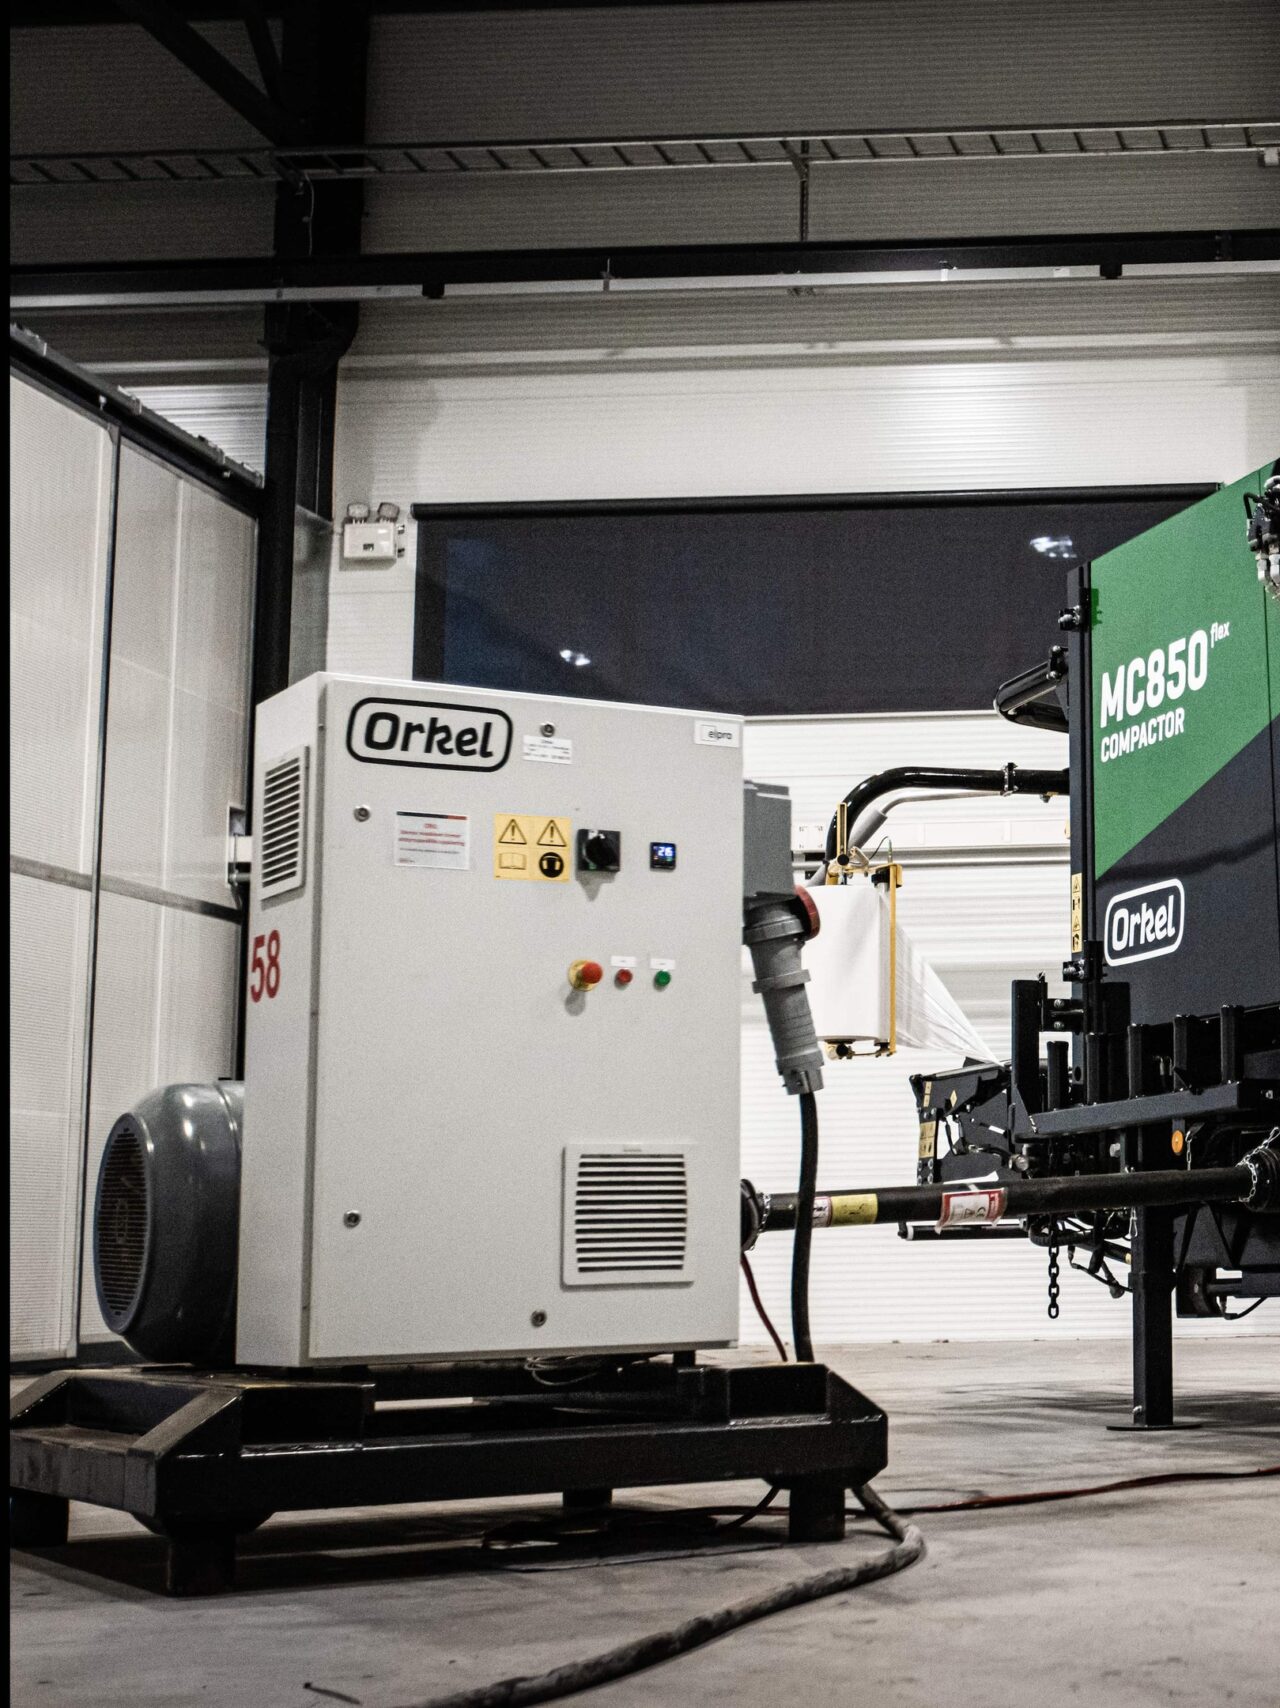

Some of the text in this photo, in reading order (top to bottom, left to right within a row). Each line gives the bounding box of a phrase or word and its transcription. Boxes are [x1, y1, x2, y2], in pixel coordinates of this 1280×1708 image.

[1100, 621, 1230, 729] MC850 flex
[364, 711, 494, 758] Orkel
[1100, 707, 1185, 763] COMPACTOR
[1112, 894, 1176, 952] Orkel
[250, 929, 281, 1003] 58
